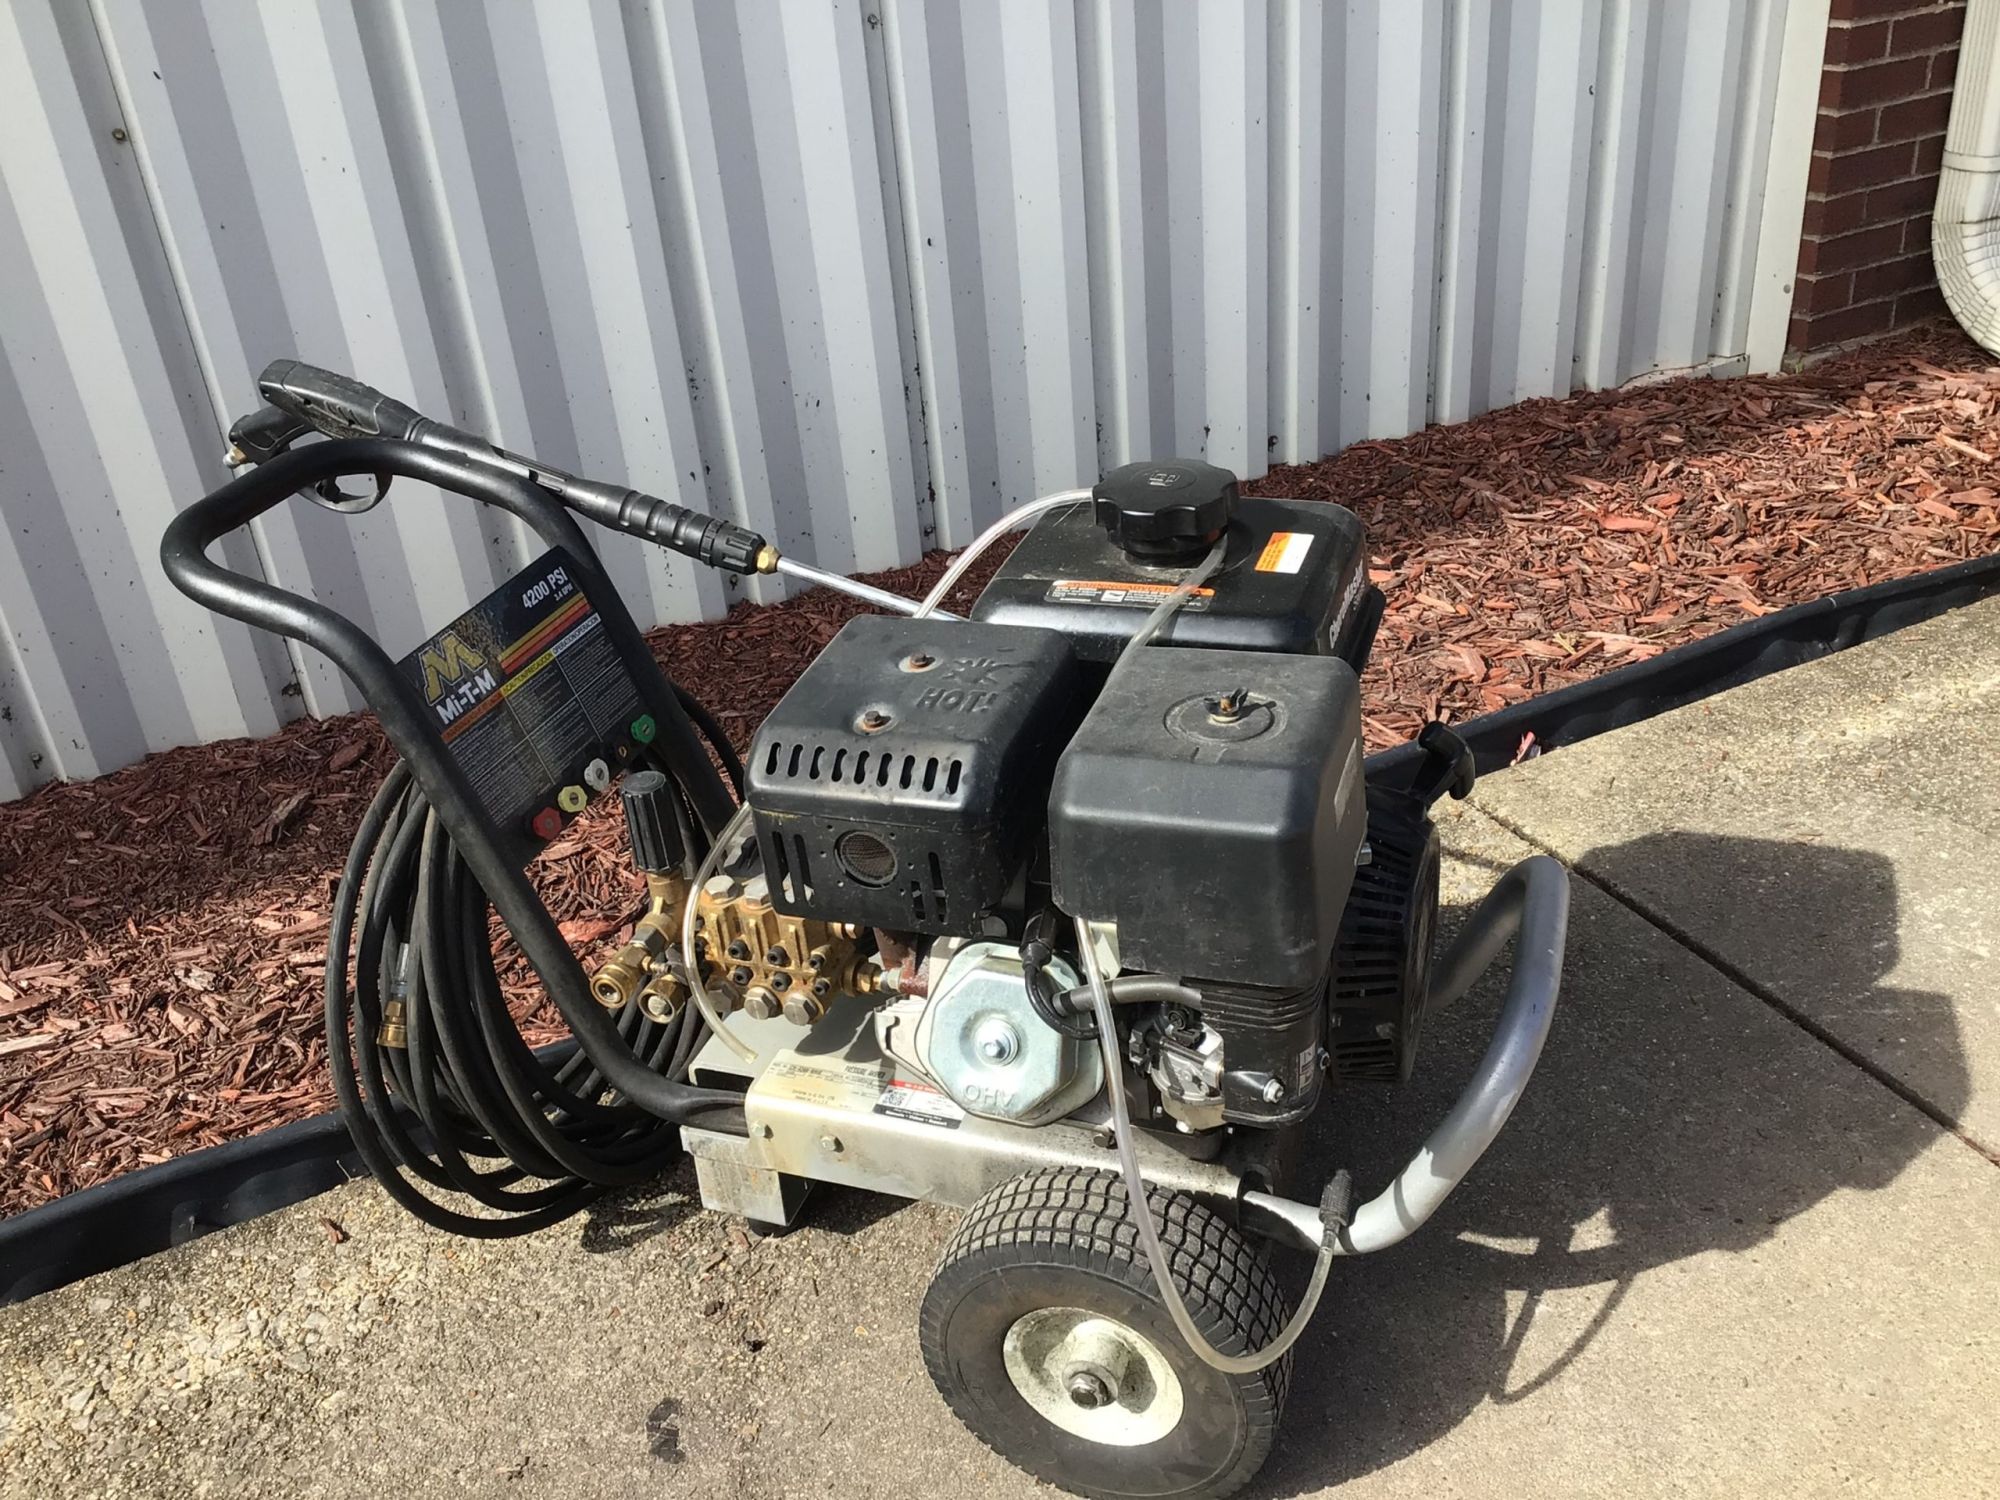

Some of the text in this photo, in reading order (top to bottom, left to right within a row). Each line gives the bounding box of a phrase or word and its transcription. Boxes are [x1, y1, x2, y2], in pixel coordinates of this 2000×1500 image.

[522, 566, 568, 608] 4200 PSI
[435, 668, 497, 725] Mi-T-M
[963, 1084, 1017, 1108] OHV
